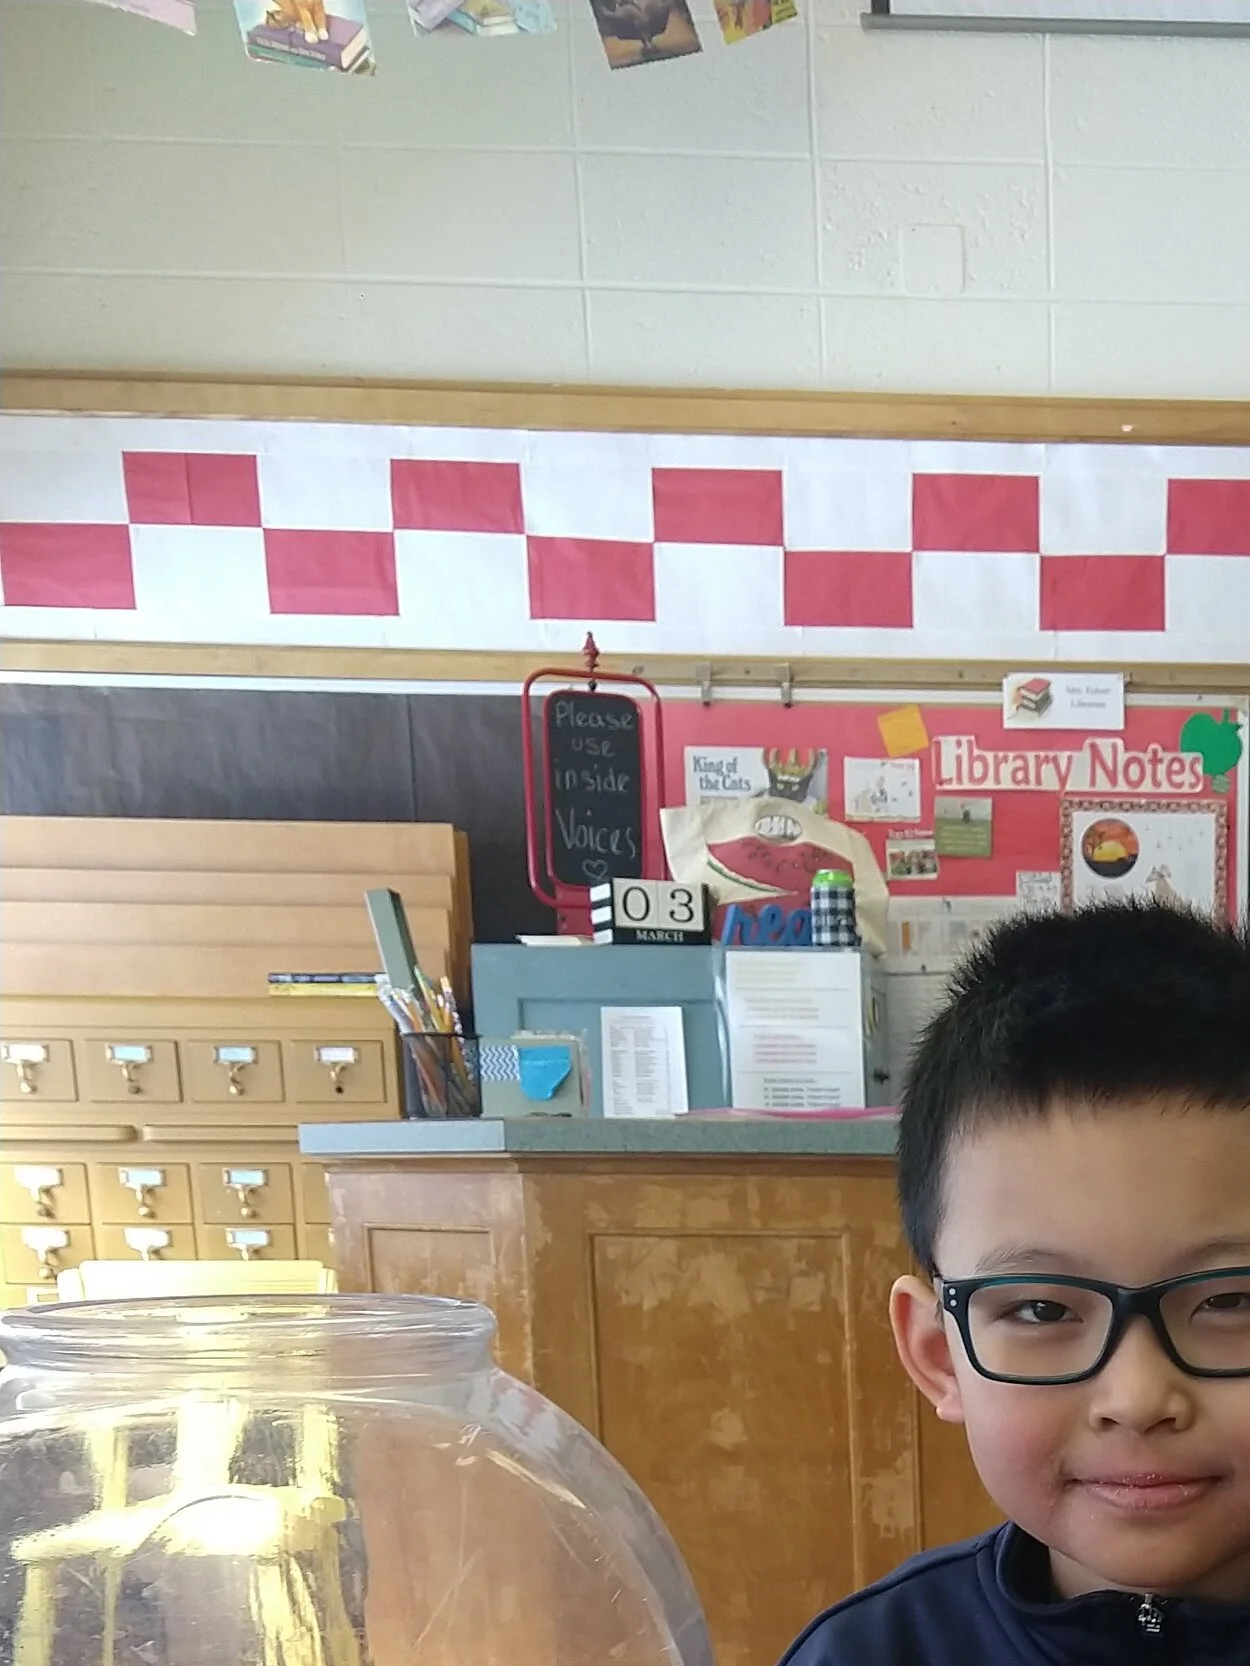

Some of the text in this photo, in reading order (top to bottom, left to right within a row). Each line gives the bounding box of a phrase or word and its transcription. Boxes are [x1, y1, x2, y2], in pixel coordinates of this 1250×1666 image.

[555, 701, 634, 731] Please
[572, 736, 615, 758] use
[554, 763, 630, 793] inside
[693, 756, 737, 776] King of
[933, 737, 1201, 796] Library Notes
[700, 775, 751, 791] the Cats
[636, 929, 684, 942] MARCH
[722, 904, 812, 945] rea
